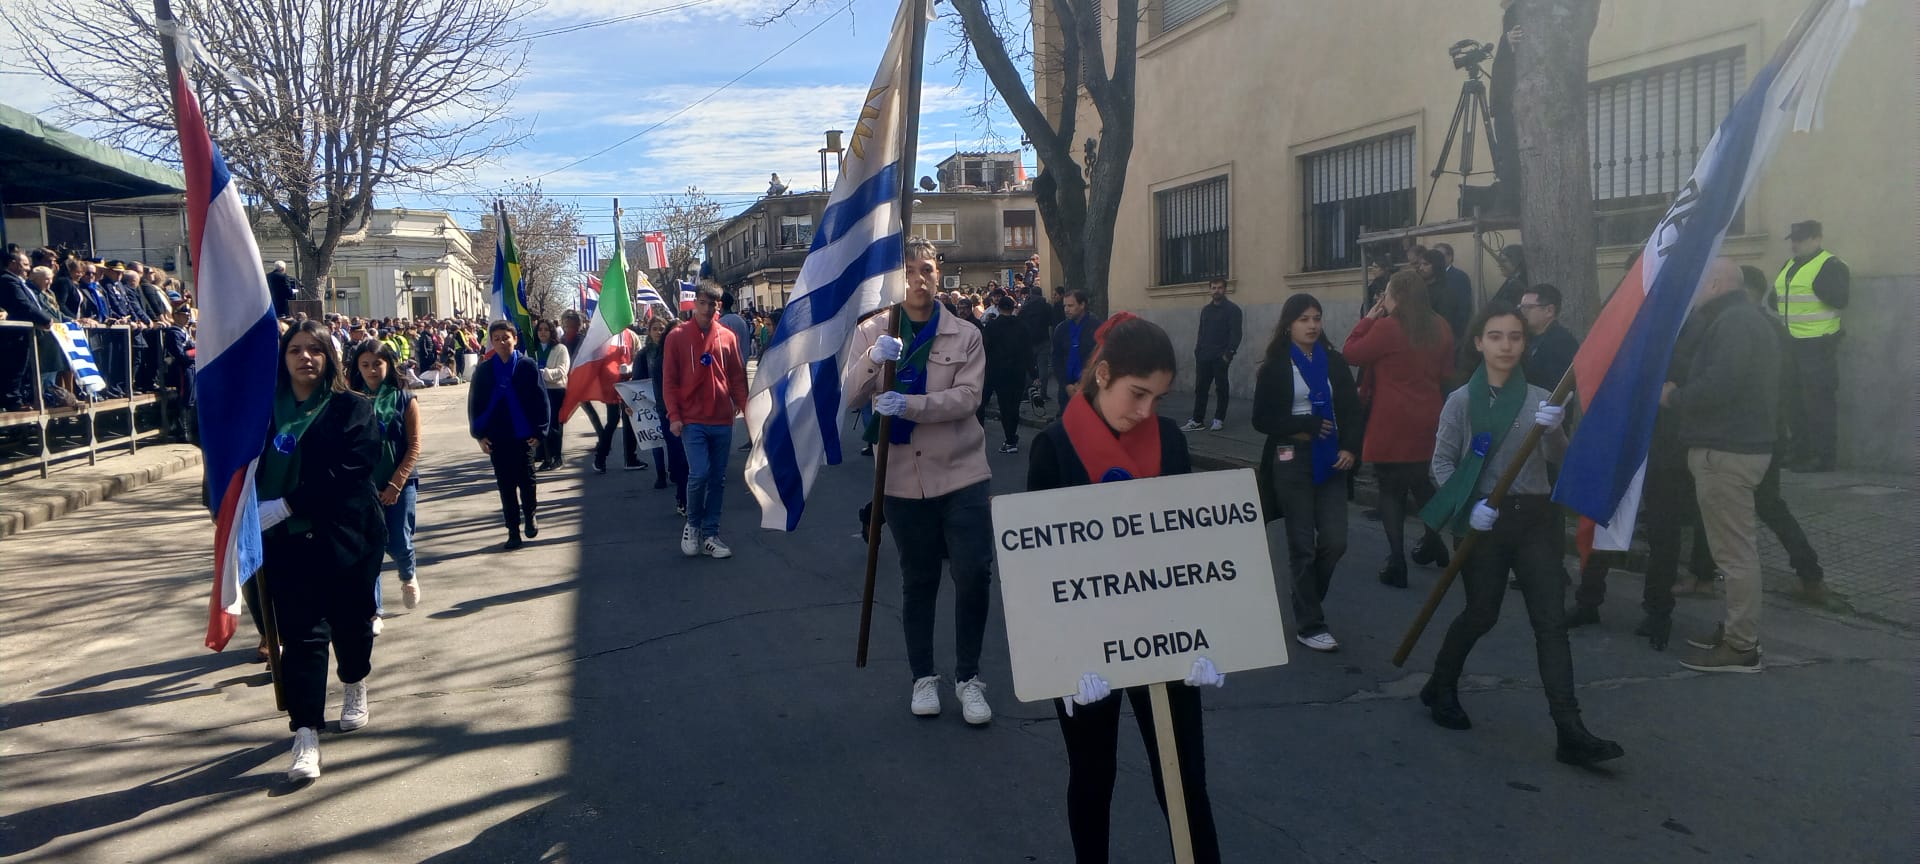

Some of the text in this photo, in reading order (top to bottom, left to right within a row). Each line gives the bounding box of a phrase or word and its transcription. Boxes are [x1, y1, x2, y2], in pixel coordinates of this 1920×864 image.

[1001, 502, 1257, 551] CENTRO DE LENGUAS
[1052, 560, 1237, 603] EXTRANJERAS
[1103, 629, 1209, 663] FLORIDA
